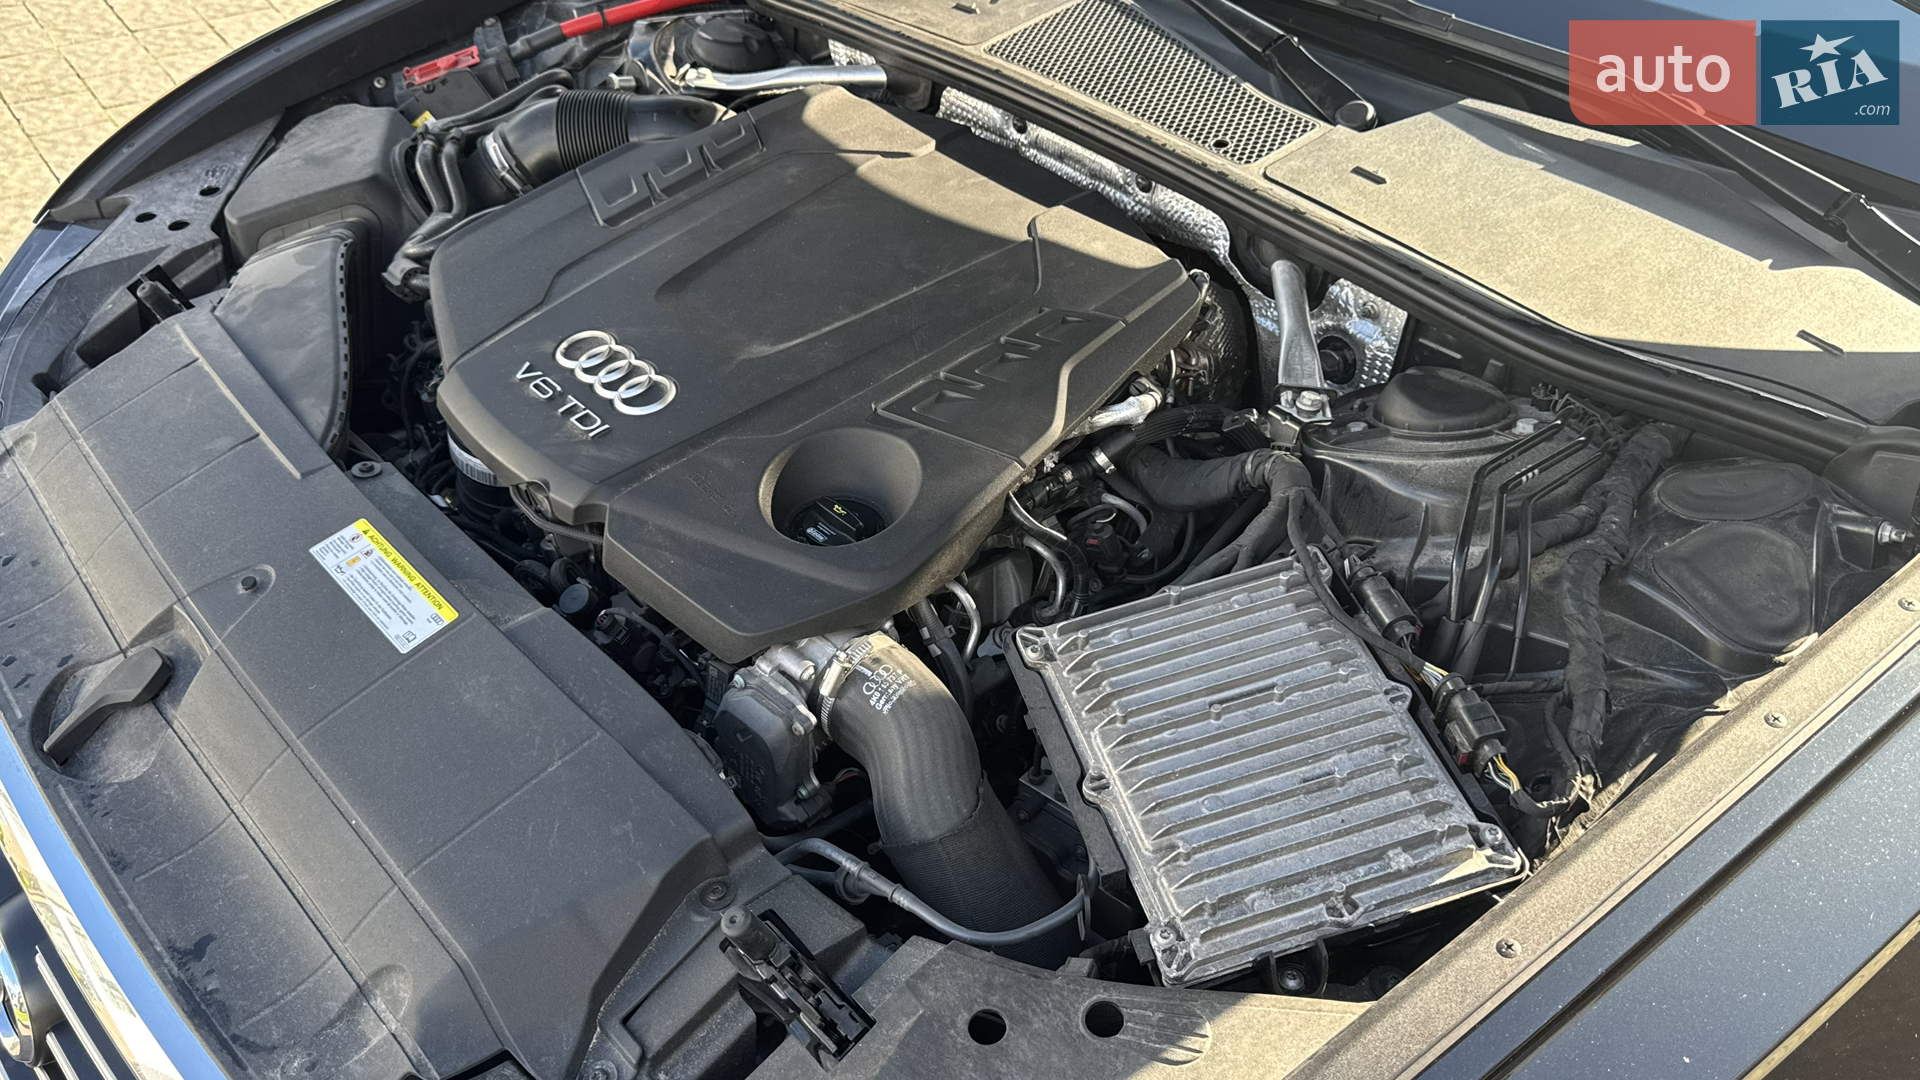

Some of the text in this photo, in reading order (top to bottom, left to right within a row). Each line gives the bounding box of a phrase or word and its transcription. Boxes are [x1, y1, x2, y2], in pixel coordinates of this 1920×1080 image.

[515, 361, 611, 438] V6 TDI
[368, 534, 393, 558] ACHTUNG
[391, 557, 416, 582] WARNING
[414, 582, 445, 611] ATTENTION
